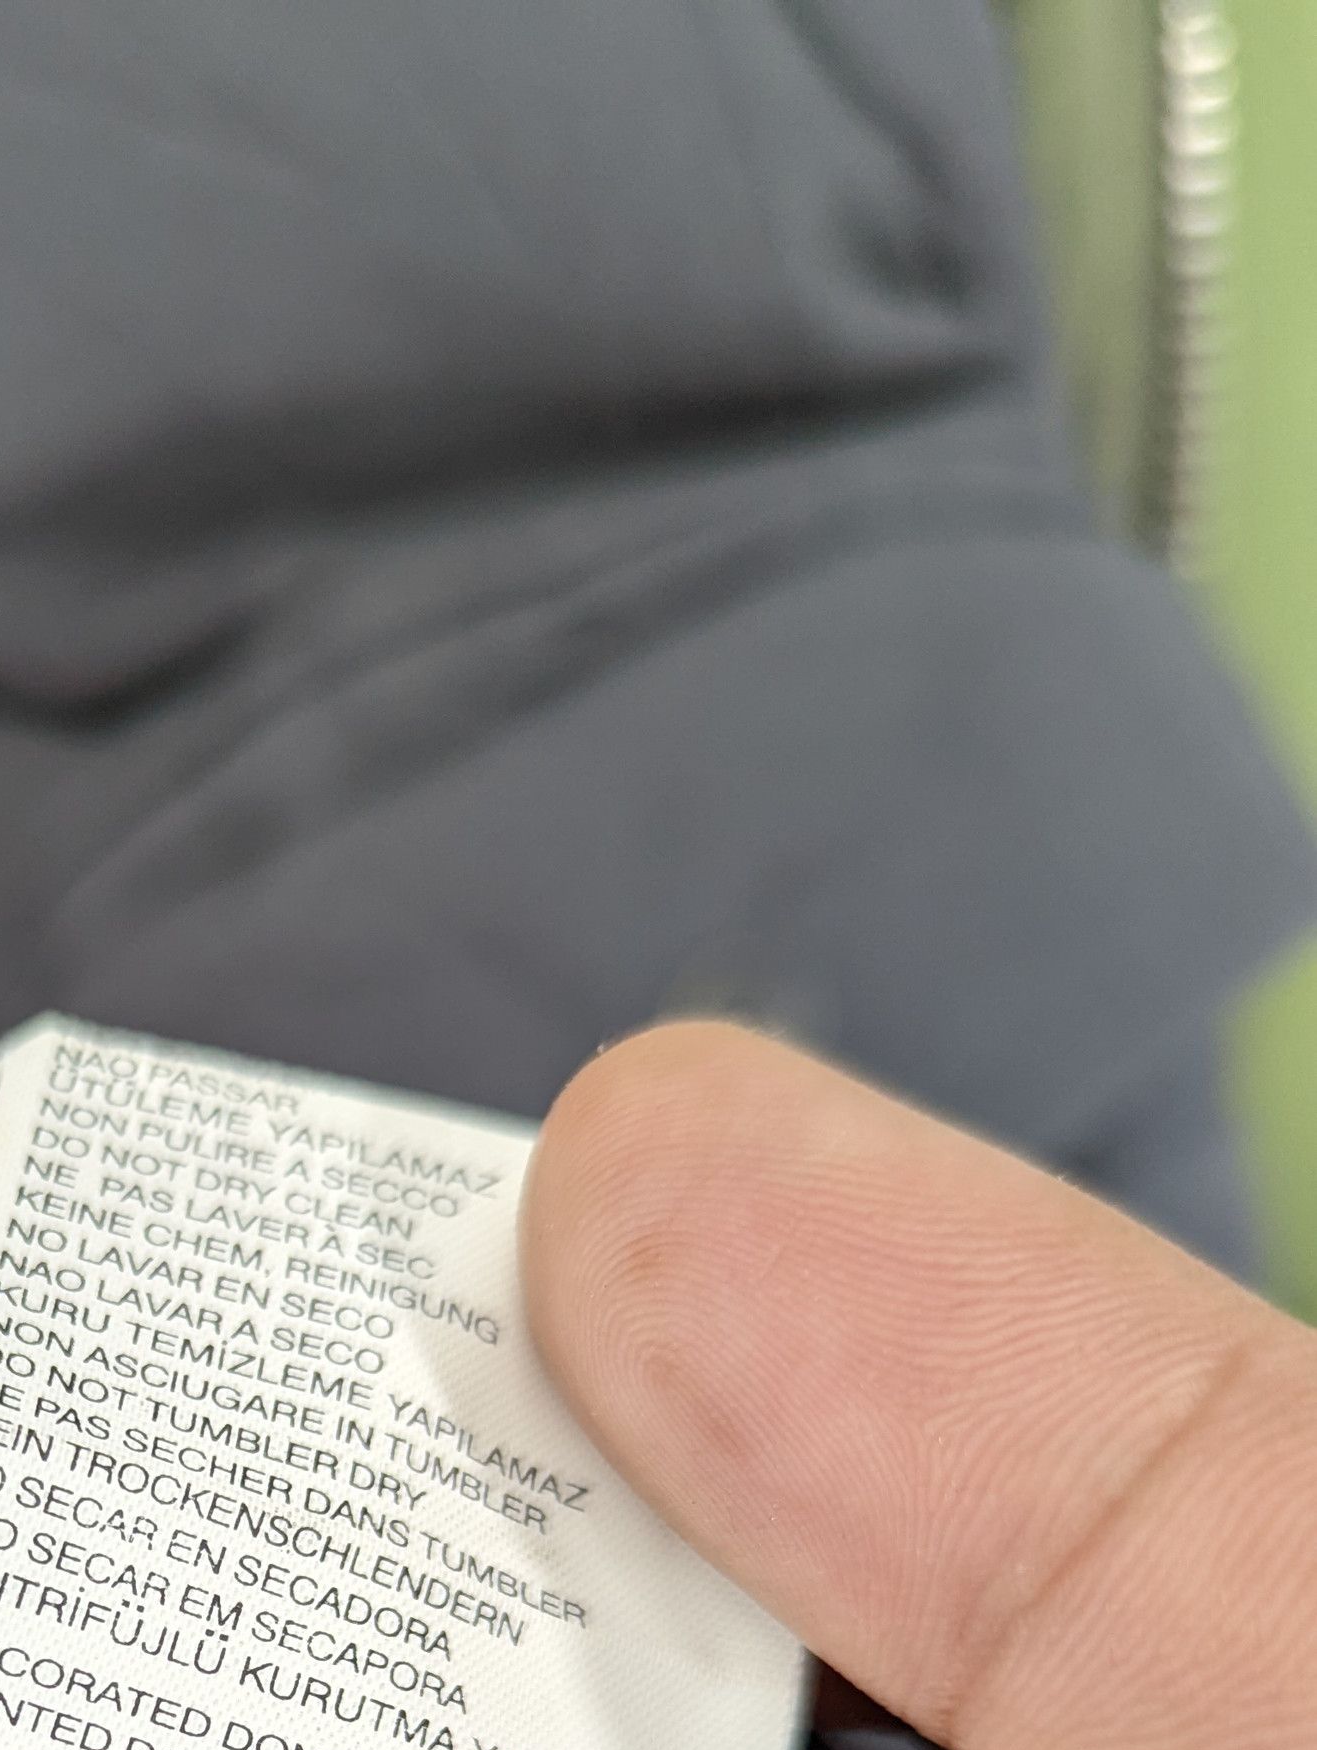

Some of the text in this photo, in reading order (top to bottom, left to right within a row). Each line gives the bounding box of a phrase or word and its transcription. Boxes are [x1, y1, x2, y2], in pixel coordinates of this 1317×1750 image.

[49, 1065, 501, 1199] ÜTÜLEME YAPILAMAZ
[55, 1045, 300, 1114] NAO PASSAR
[23, 1155, 80, 1189] NE
[100, 1177, 174, 1213] PAS
[185, 1200, 309, 1249] LAVER
[355, 1243, 435, 1280] SEC
[32, 1126, 413, 1241] DO NOT DRY CLEAN
[39, 1098, 459, 1218] NON PULIRE A SECCO
[6, 1218, 394, 1340] NO LAVAR EN SECO
[15, 1186, 134, 1238] KEINE
[285, 1257, 499, 1346] REINIGUNG
[96, 1279, 223, 1335] LAVAR
[231, 1319, 259, 1345] A
[270, 1327, 384, 1375] SECO
[47, 1365, 138, 1411] NOT
[145, 1396, 339, 1480] TUMBLER
[349, 1460, 427, 1511] DRY
[83, 1346, 325, 1436] ASCIUGARE
[335, 1416, 375, 1451] IN
[384, 1432, 546, 1535] TUMBLER
[388, 1393, 588, 1513] YAPILAMAZ
[15, 1476, 158, 1551] SECAR
[166, 1529, 227, 1575] EN
[233, 1555, 451, 1662] SECADORA
[34, 1396, 111, 1440] PAS
[122, 1428, 293, 1505] SECHER
[303, 1487, 410, 1548] DANS
[419, 1531, 587, 1630] TUMBLER
[65, 1441, 524, 1647] TROCKENSCHLENDERN
[27, 1532, 171, 1606] SECAR
[179, 1584, 244, 1631] EM
[251, 1611, 467, 1715] SECAPORA
